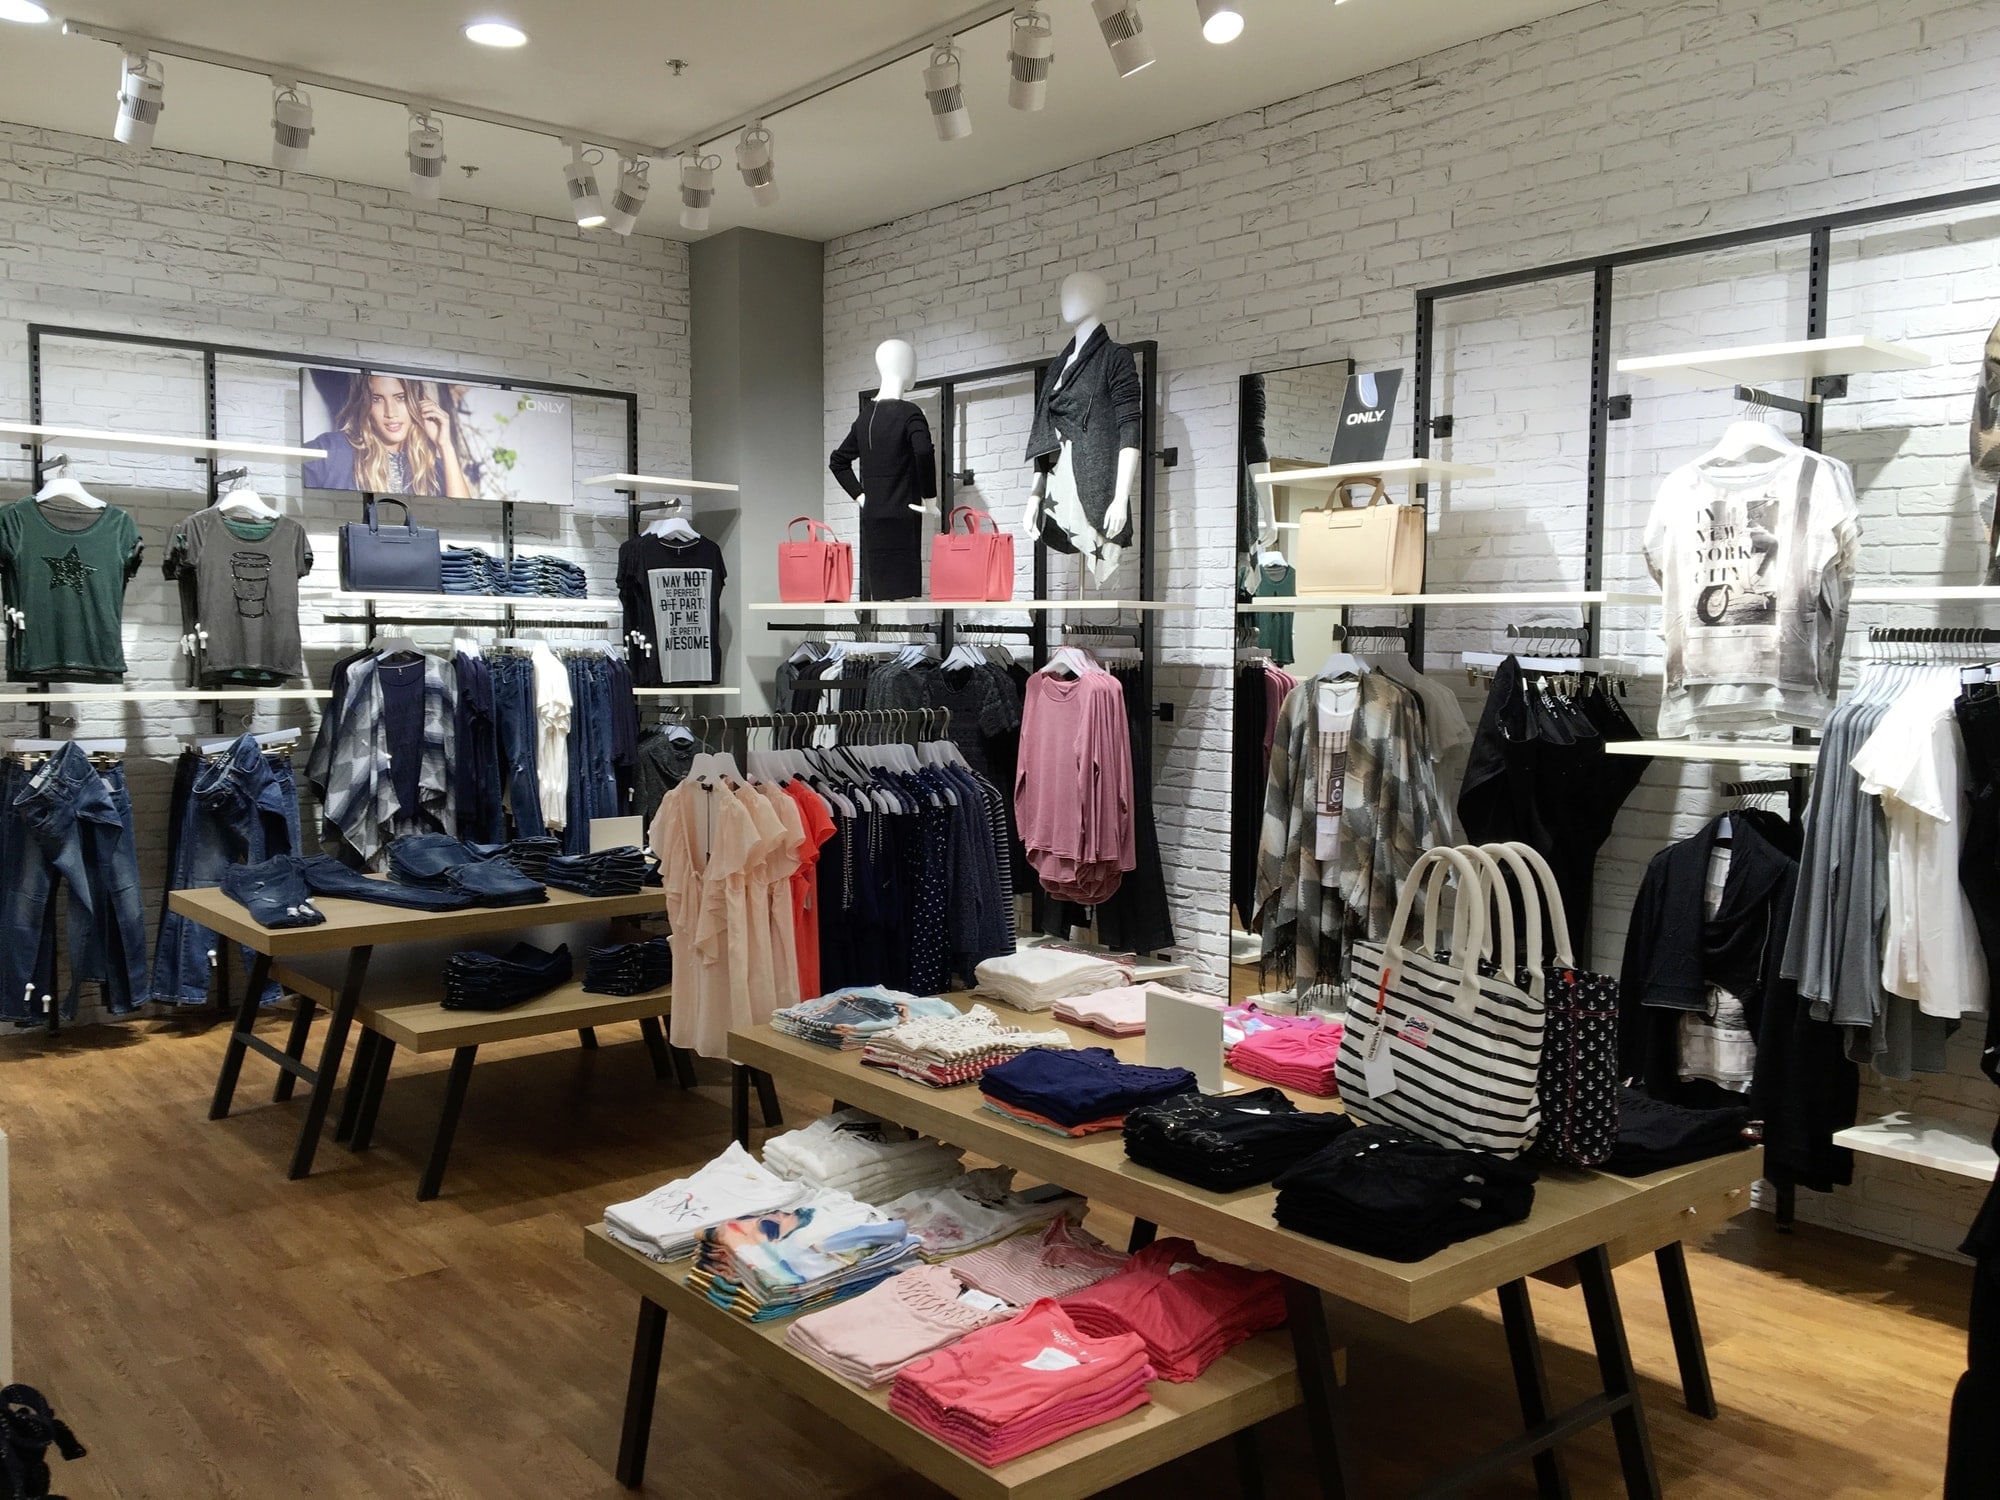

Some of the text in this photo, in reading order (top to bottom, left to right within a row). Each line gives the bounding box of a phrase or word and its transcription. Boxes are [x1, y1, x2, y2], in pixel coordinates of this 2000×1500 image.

[525, 400, 565, 413] ONLY
[1346, 409, 1386, 425] ONLY
[1696, 545, 1751, 563] YORK
[662, 575, 681, 588] MAY
[684, 571, 707, 587] NOT
[1695, 566, 1739, 584] CITY
[673, 588, 700, 597] PERFECT
[660, 598, 677, 611] BT
[686, 611, 699, 623] ME
[679, 627, 701, 636] PRETTY
